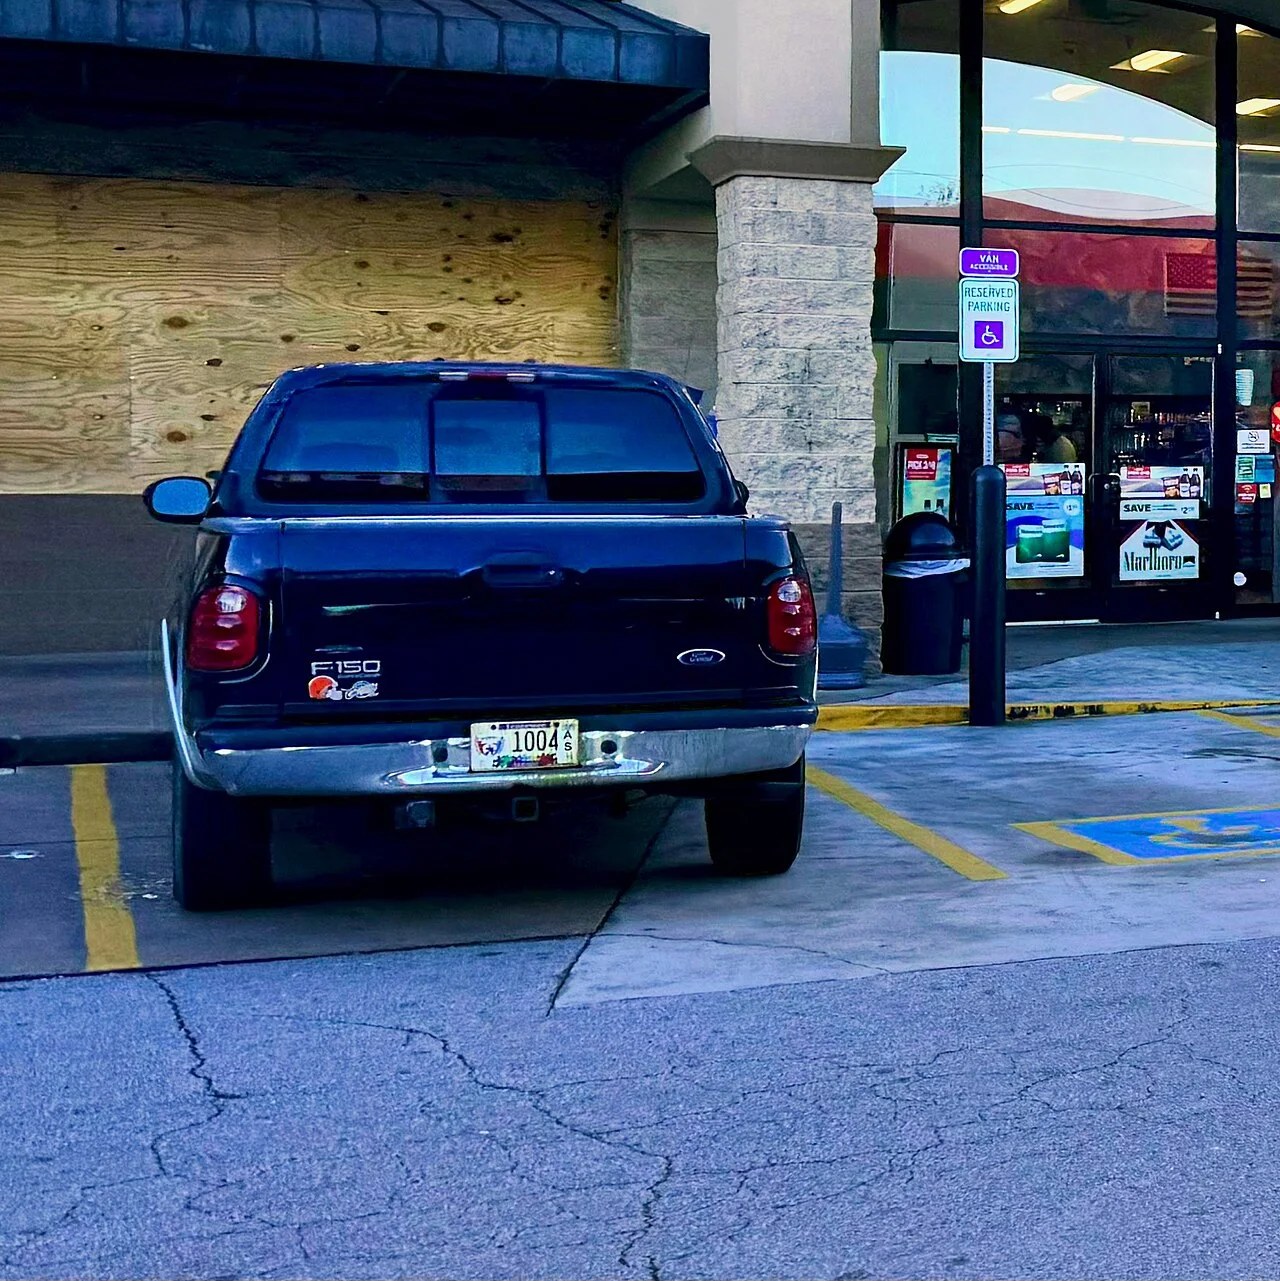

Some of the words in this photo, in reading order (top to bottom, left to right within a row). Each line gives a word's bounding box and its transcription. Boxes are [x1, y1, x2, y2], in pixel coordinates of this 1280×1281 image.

[979, 254, 999, 264] VAN
[964, 286, 1014, 298] RESERVED
[967, 300, 1011, 312] PARKING
[1006, 502, 1035, 511] SAVE
[1123, 503, 1152, 513] SAVE
[1124, 546, 1182, 572] Marlboro
[512, 729, 559, 753] 1004
